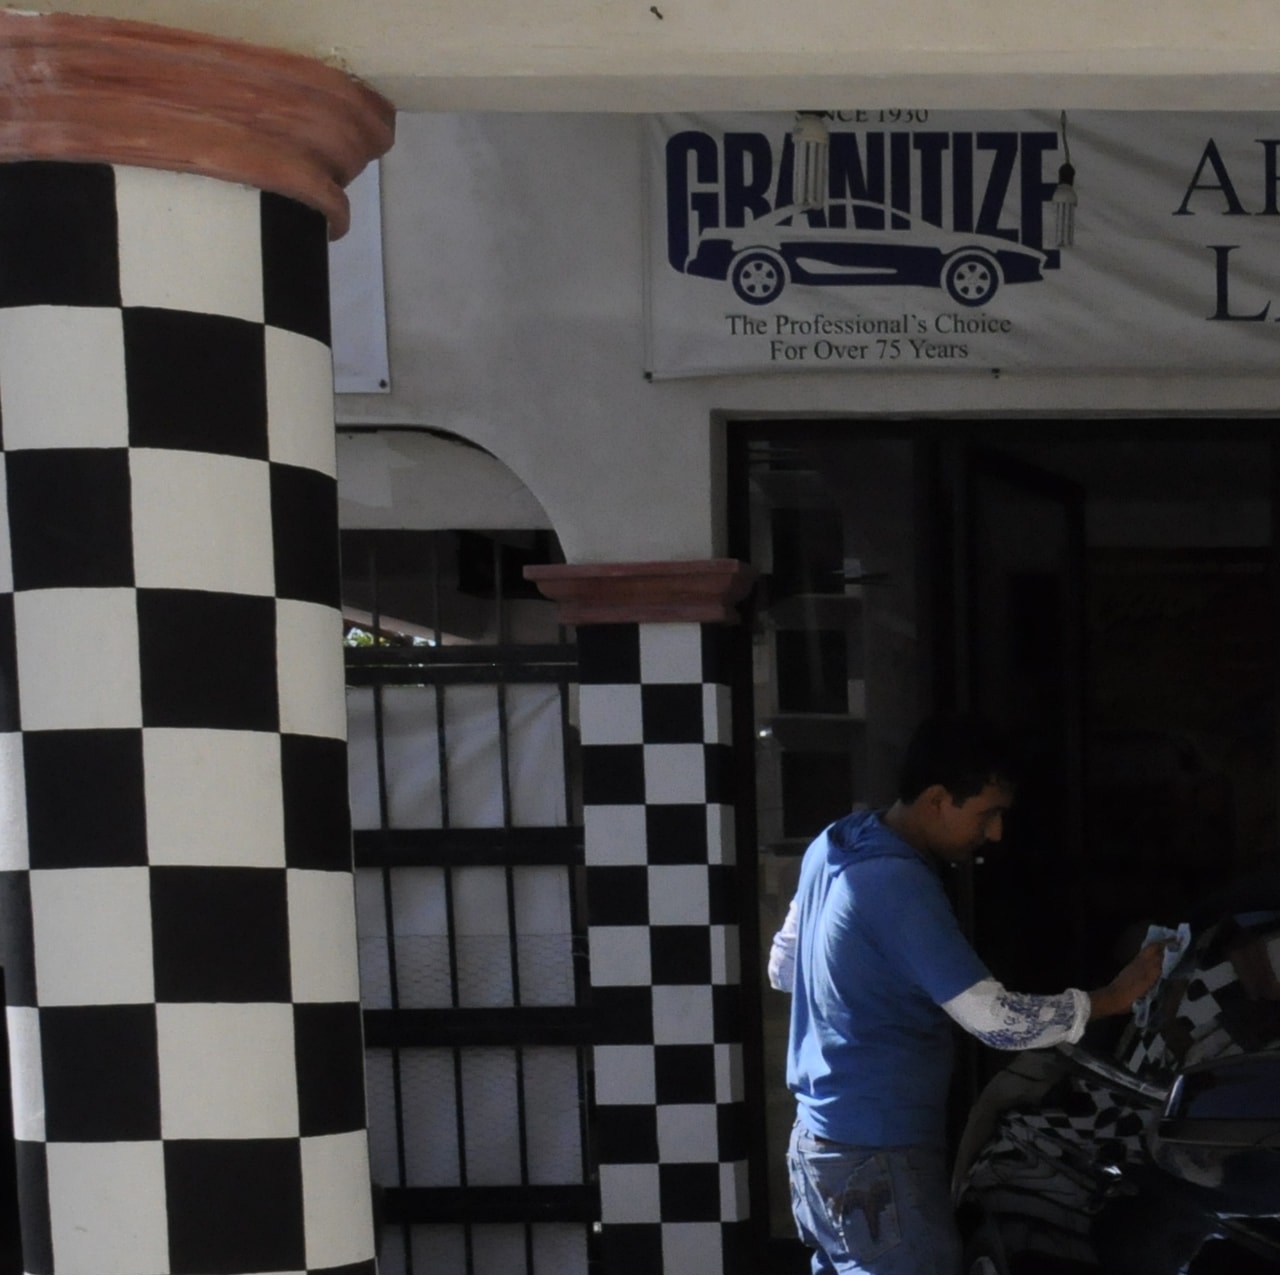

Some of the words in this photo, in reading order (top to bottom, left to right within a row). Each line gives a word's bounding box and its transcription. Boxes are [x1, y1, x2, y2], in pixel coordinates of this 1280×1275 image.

[725, 314, 767, 336] The
[776, 314, 928, 336] Professional's
[934, 313, 1012, 334] Choice
[769, 340, 808, 360] For
[813, 340, 870, 360] Over
[876, 339, 901, 359] 75
[907, 338, 969, 359] Years
